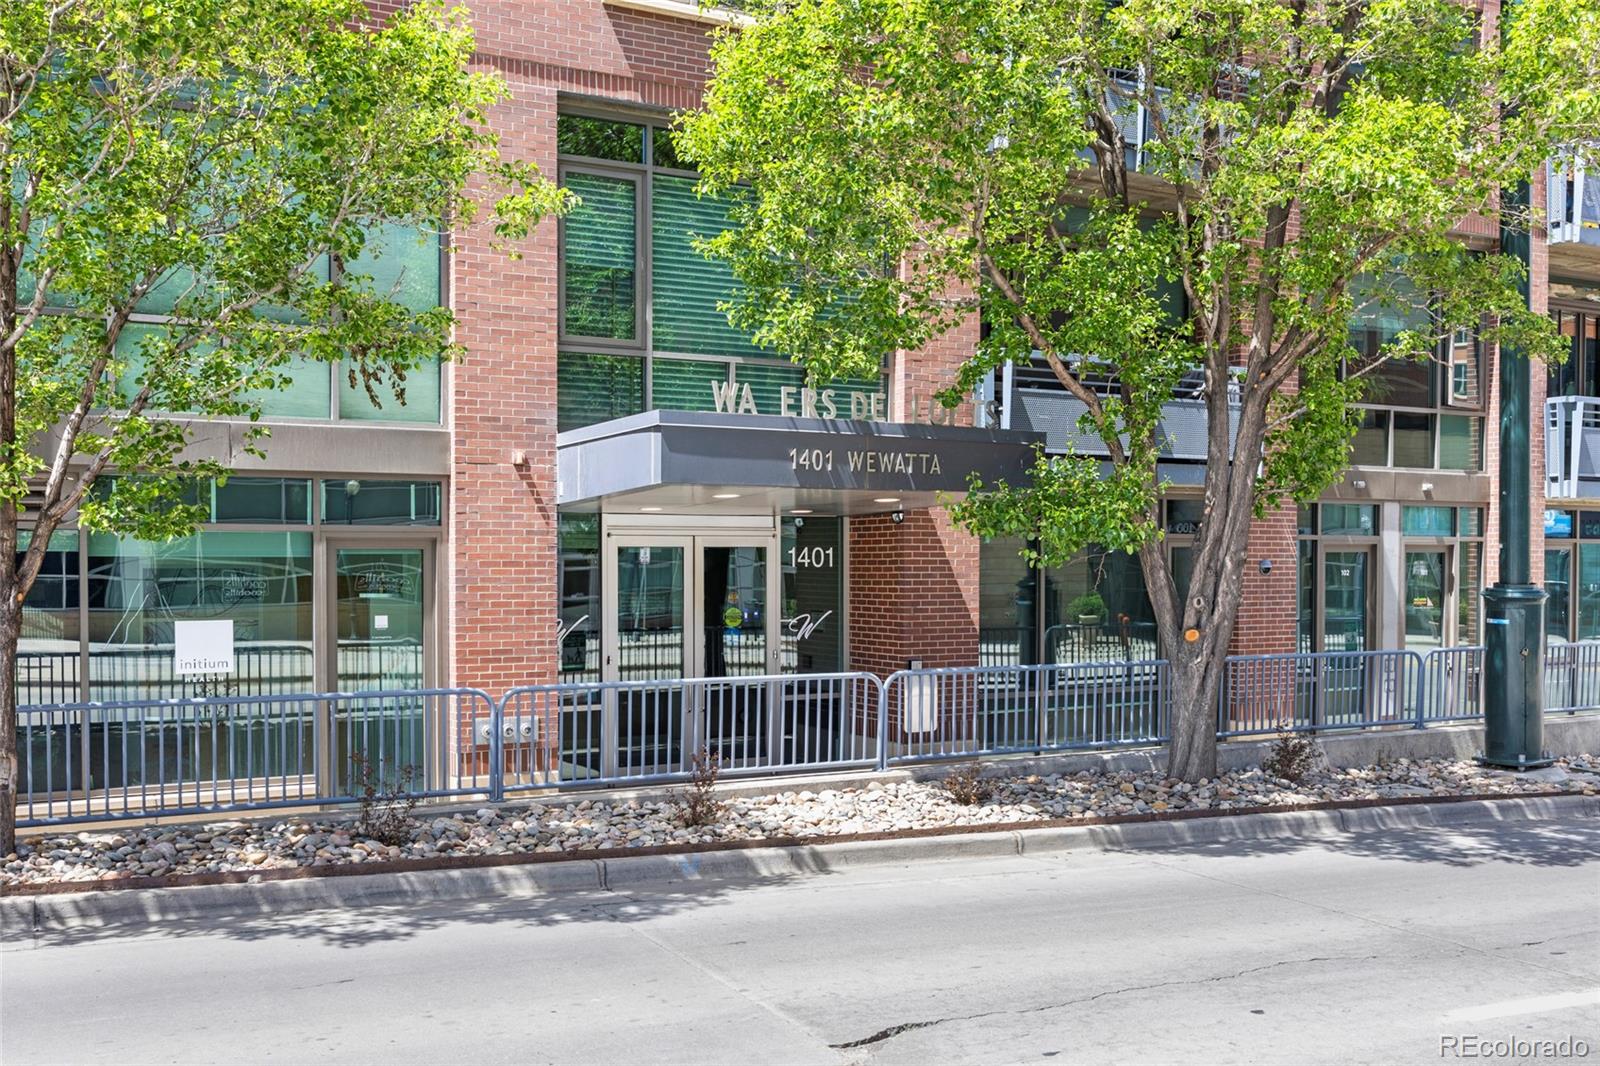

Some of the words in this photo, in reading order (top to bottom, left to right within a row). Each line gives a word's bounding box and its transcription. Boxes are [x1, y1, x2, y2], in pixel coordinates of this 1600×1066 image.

[711, 380, 887, 422] WAERSDE
[789, 448, 833, 472] 1401
[847, 451, 941, 475] WEWATTA
[788, 547, 833, 567] 1401
[788, 610, 832, 641] W
[180, 658, 229, 670] initium
